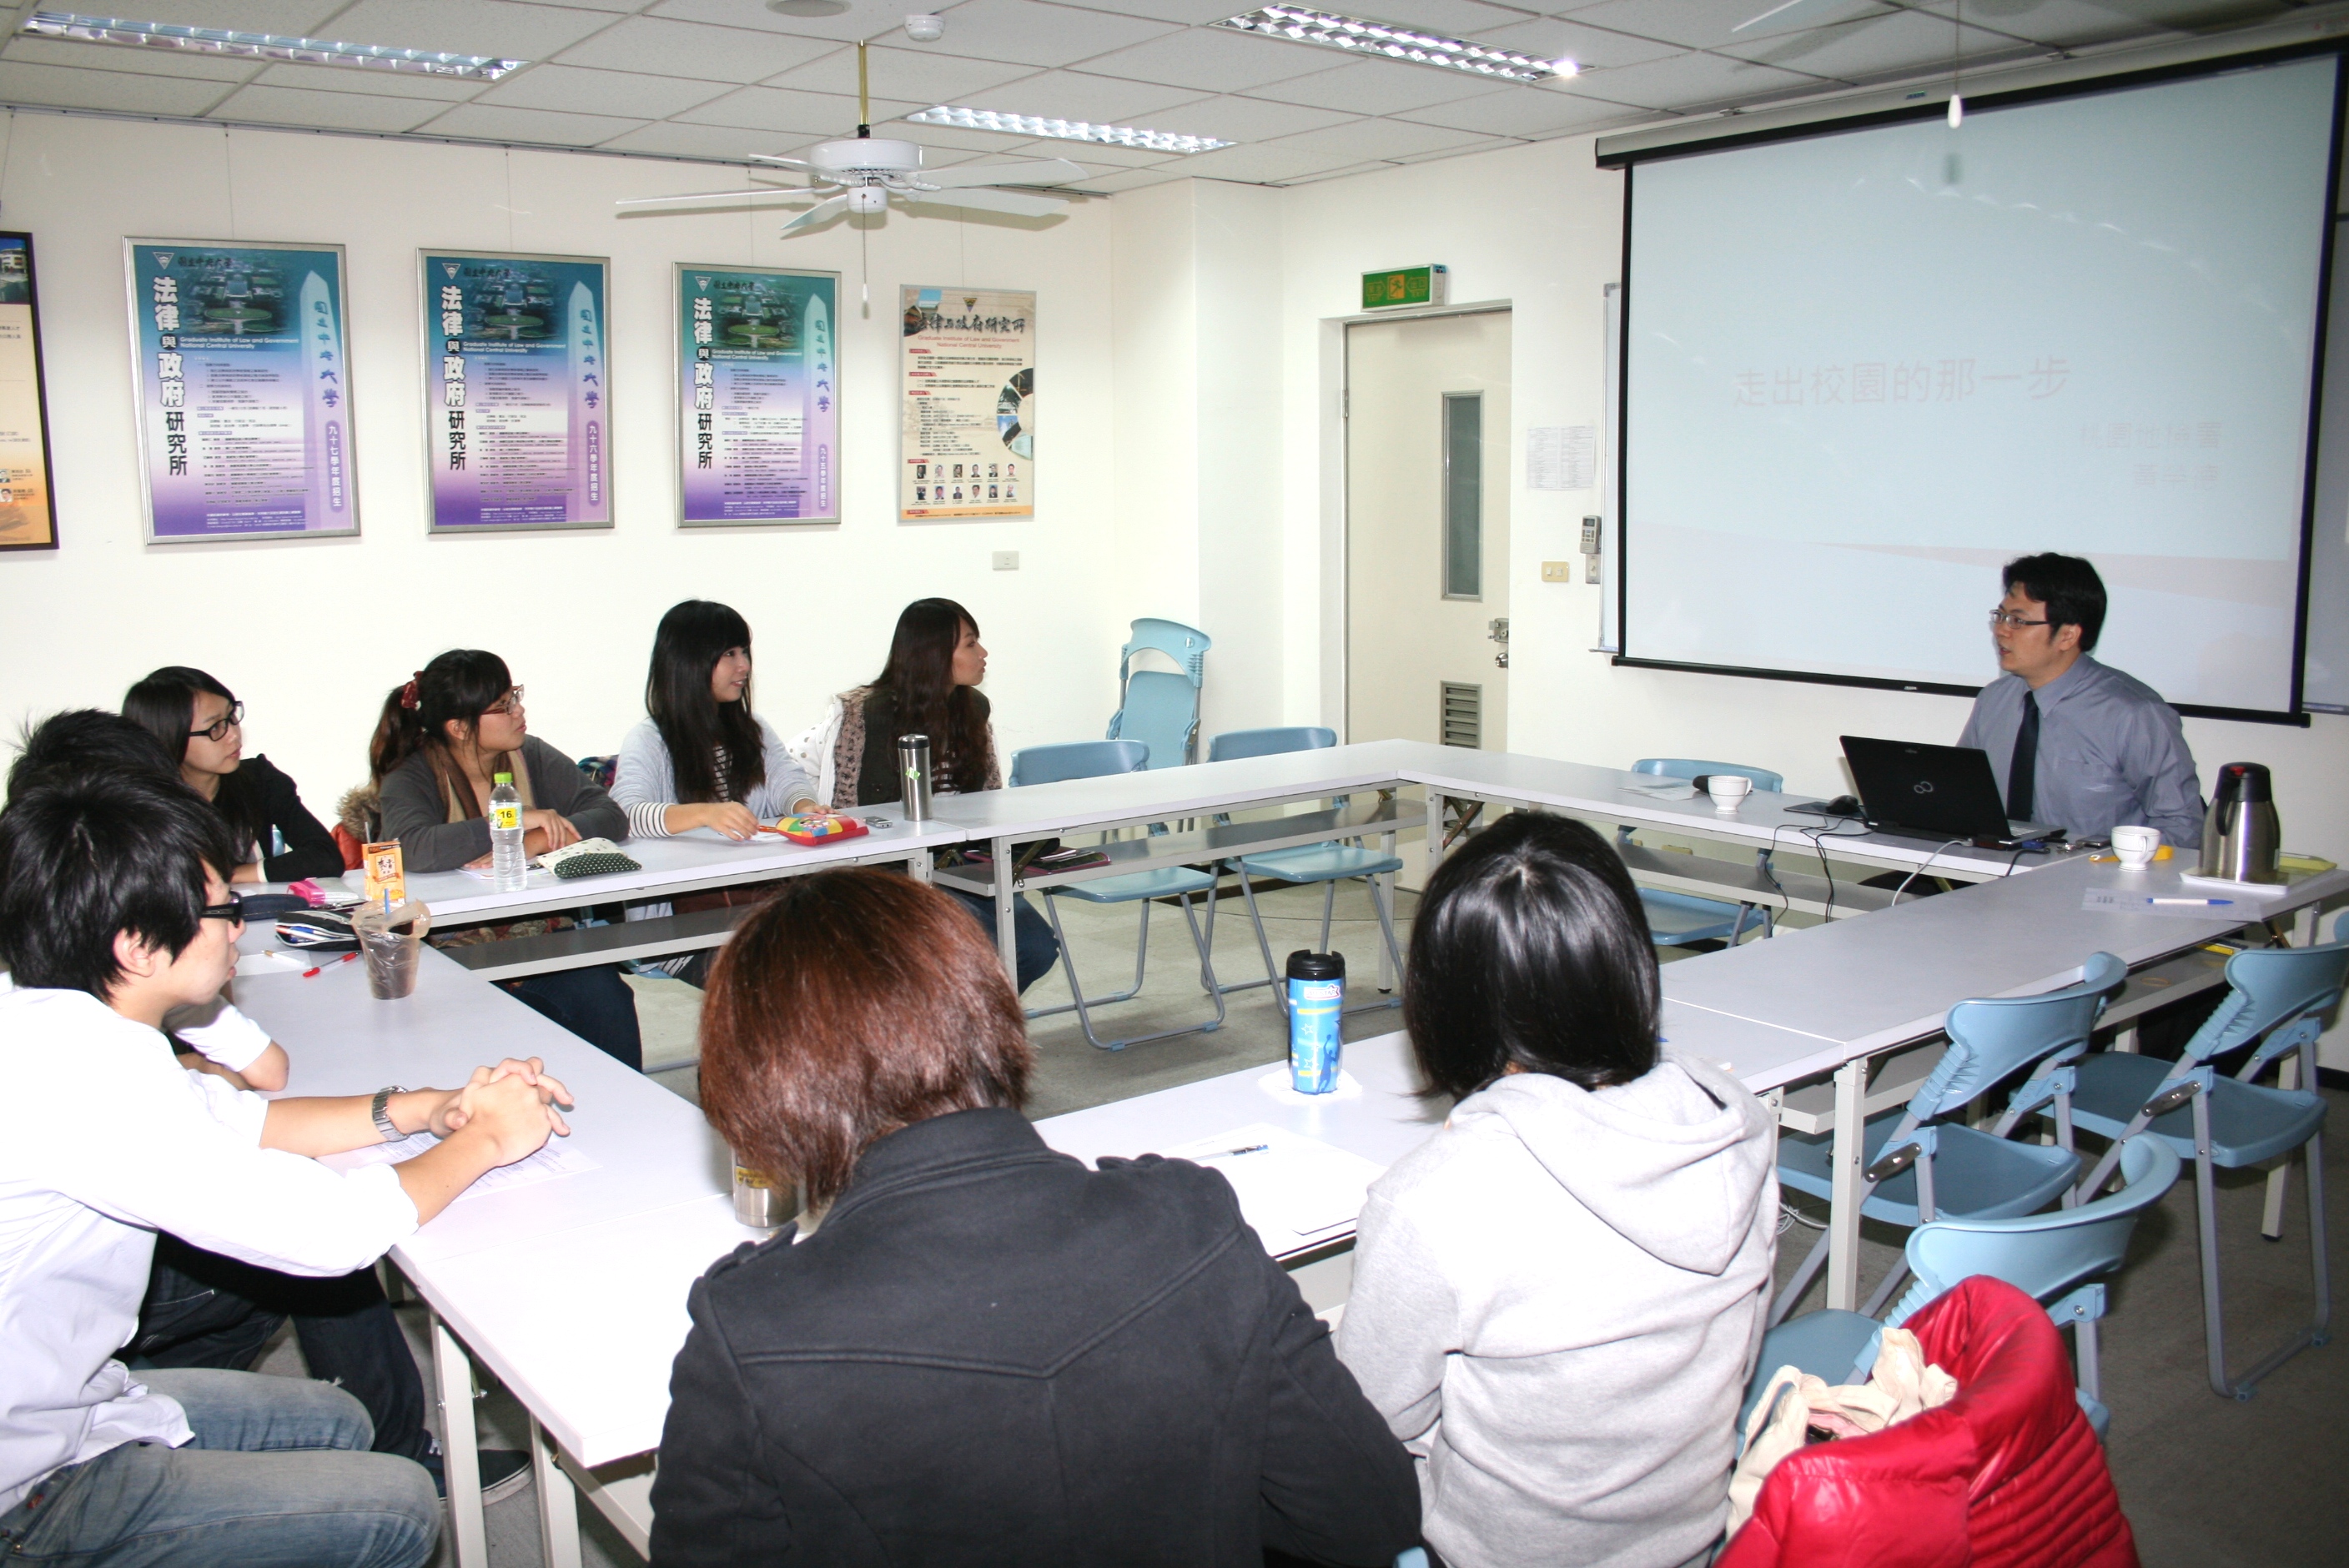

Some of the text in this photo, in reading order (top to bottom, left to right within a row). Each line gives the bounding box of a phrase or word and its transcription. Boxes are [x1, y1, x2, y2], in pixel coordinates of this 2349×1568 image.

[152, 276, 188, 477] 法律與政府研究所
[441, 285, 467, 471] 法律與政府研究所
[693, 297, 714, 469] 法律與政府研究所
[1733, 354, 2071, 407] 走出校園的那一步
[328, 426, 342, 507] 九十七學年度招生
[2080, 421, 2221, 450] 桃園地檢署
[500, 810, 512, 819] 16
